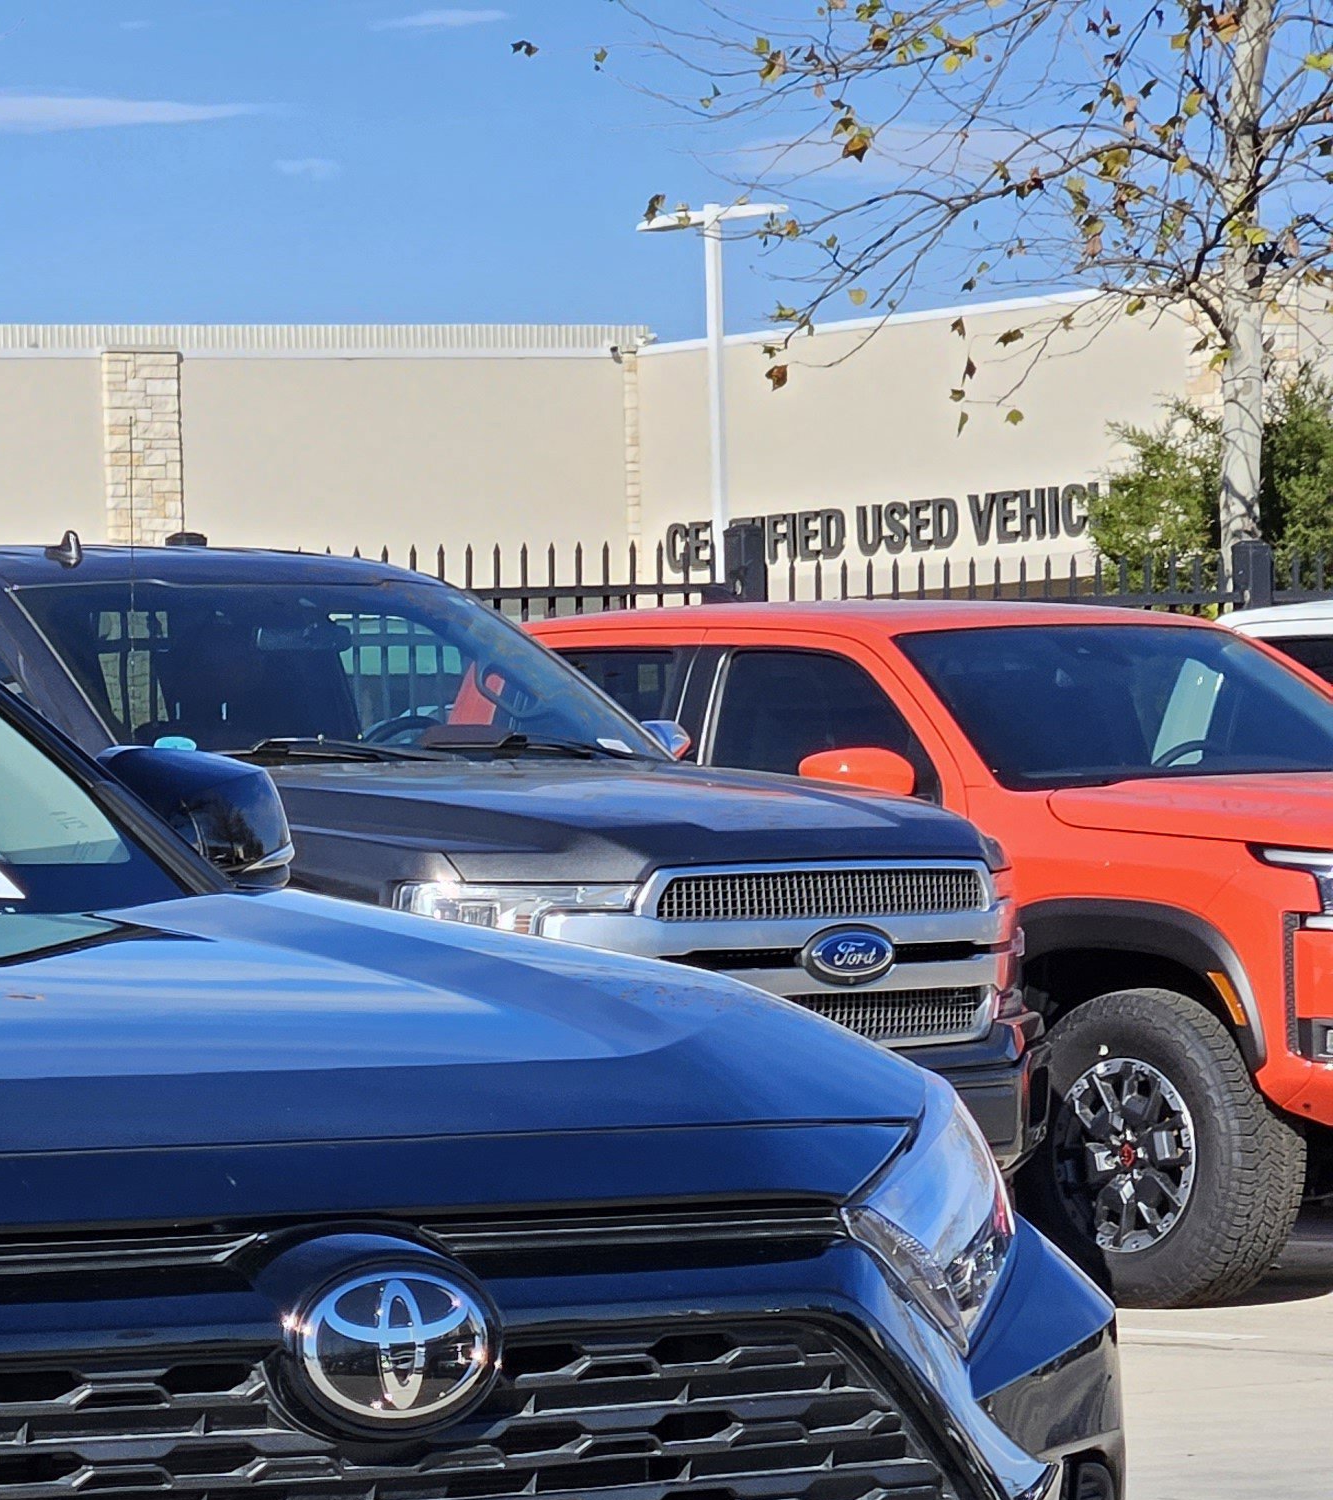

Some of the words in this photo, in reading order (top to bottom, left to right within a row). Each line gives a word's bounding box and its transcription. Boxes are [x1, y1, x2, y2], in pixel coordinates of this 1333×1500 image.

[666, 508, 846, 574] CEFIED
[856, 496, 959, 557] USED
[834, 941, 877, 966] Ford
